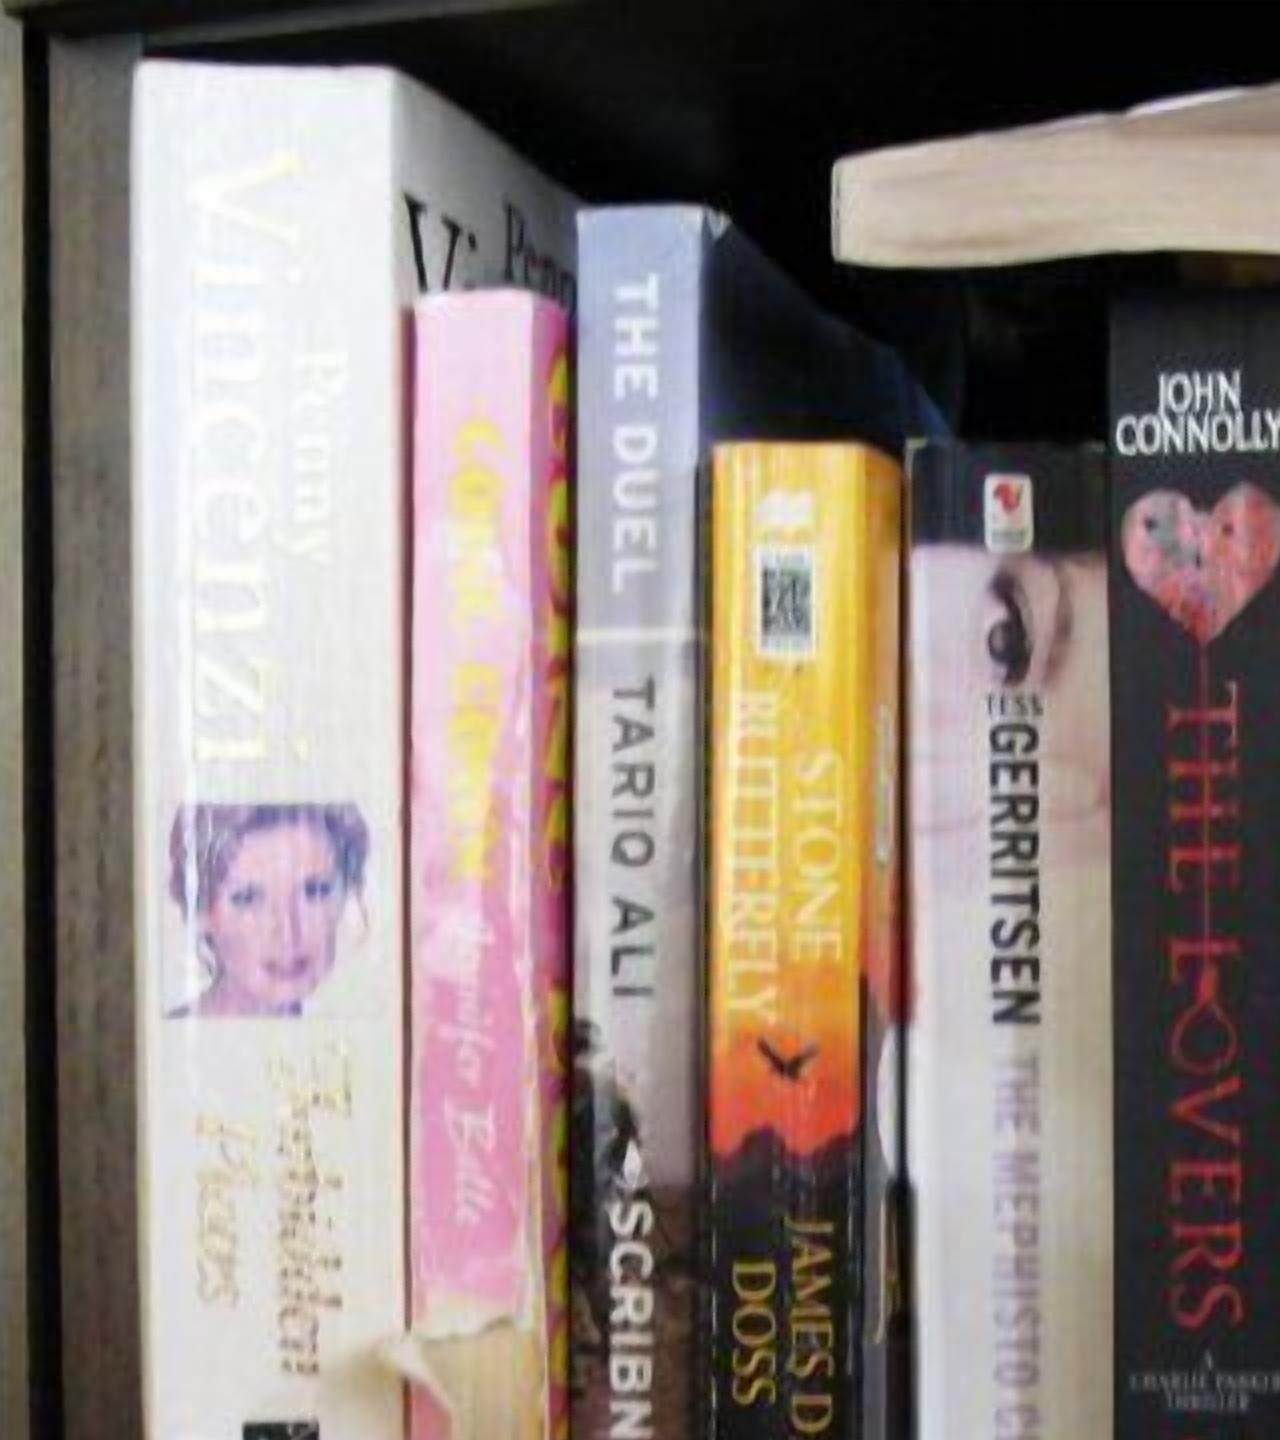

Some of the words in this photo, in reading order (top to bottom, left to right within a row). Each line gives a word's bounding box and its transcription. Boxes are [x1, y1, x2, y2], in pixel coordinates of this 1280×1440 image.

[613, 273, 658, 402] THE
[1158, 370, 1243, 416] JOHN
[190, 150, 308, 761] Vincenzi
[613, 429, 658, 594] DUEL
[609, 679, 657, 868] TARIQ
[724, 689, 778, 1023] BUTTERFLY
[793, 751, 842, 964] STONE
[1168, 678, 1243, 892] THE
[611, 898, 656, 998] ALI
[988, 719, 1042, 1026] GERRITSEN
[997, 1056, 1041, 1132] THE
[1165, 935, 1243, 1330] LOVERS
[732, 1258, 776, 1406] DOSS
[784, 1217, 835, 1378] JAMES
[994, 1150, 1041, 1388] MEPHISTO
